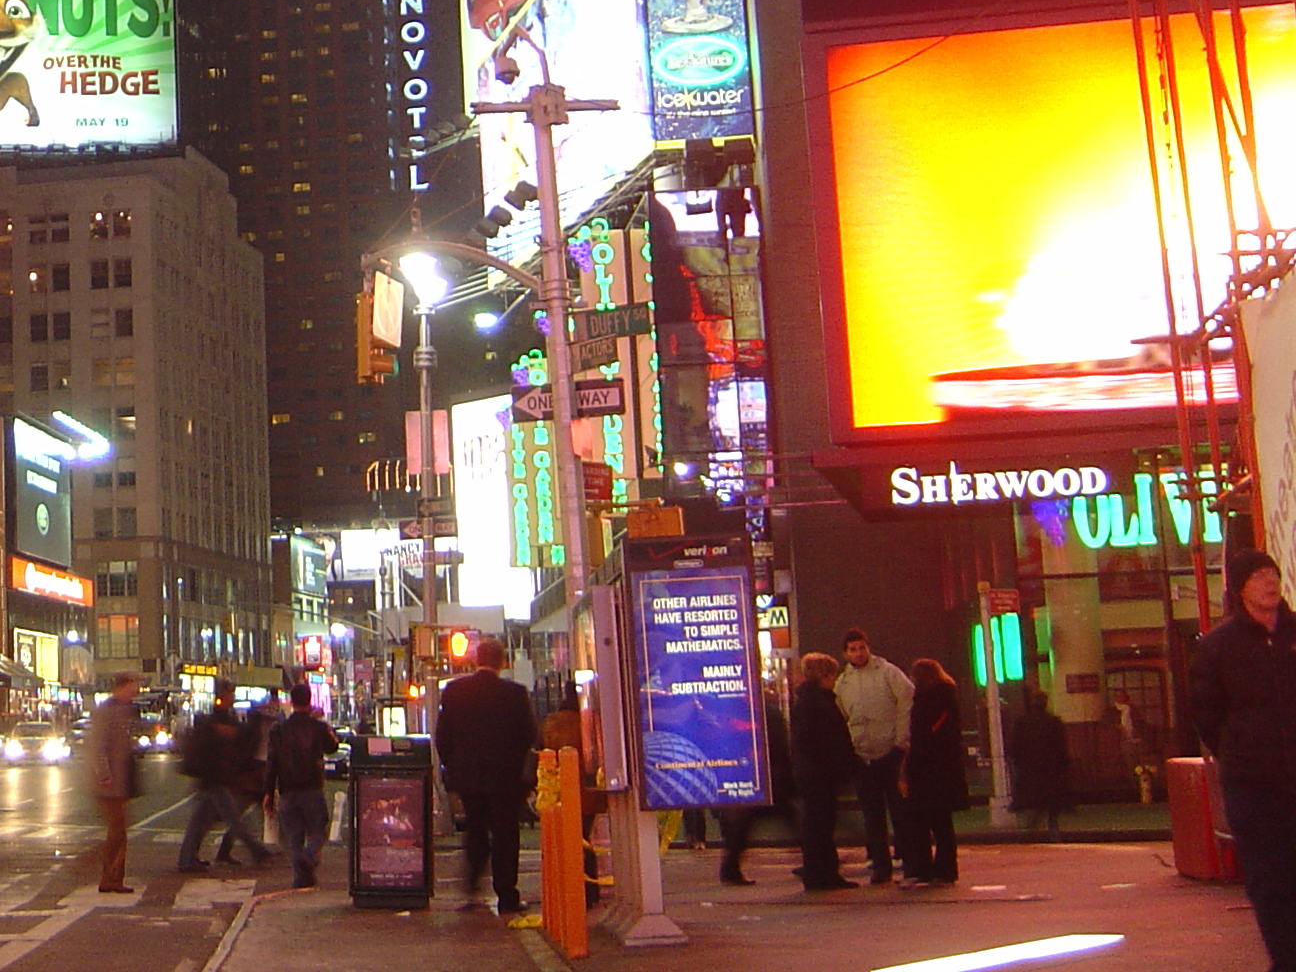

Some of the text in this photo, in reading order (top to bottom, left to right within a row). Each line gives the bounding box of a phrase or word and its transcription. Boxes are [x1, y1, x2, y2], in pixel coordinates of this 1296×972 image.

[43, 55, 122, 70] OVER THE
[59, 69, 160, 96] HEDGE
[75, 117, 129, 127] MAY 19
[589, 307, 647, 339] DUFFY SQ
[580, 339, 615, 361] ACTORS
[578, 389, 611, 407] WAY
[510, 423, 527, 478] LIVE
[891, 464, 1107, 505] SHERWOOD
[653, 593, 737, 609] OTHER AIRLINES
[654, 609, 738, 625] HAVE RESORTED
[684, 624, 739, 639] TO SIMPLE
[666, 639, 744, 654] MATHEMATICS.
[703, 665, 743, 678] MAINLY
[671, 680, 747, 695] SUBTRACTION.
